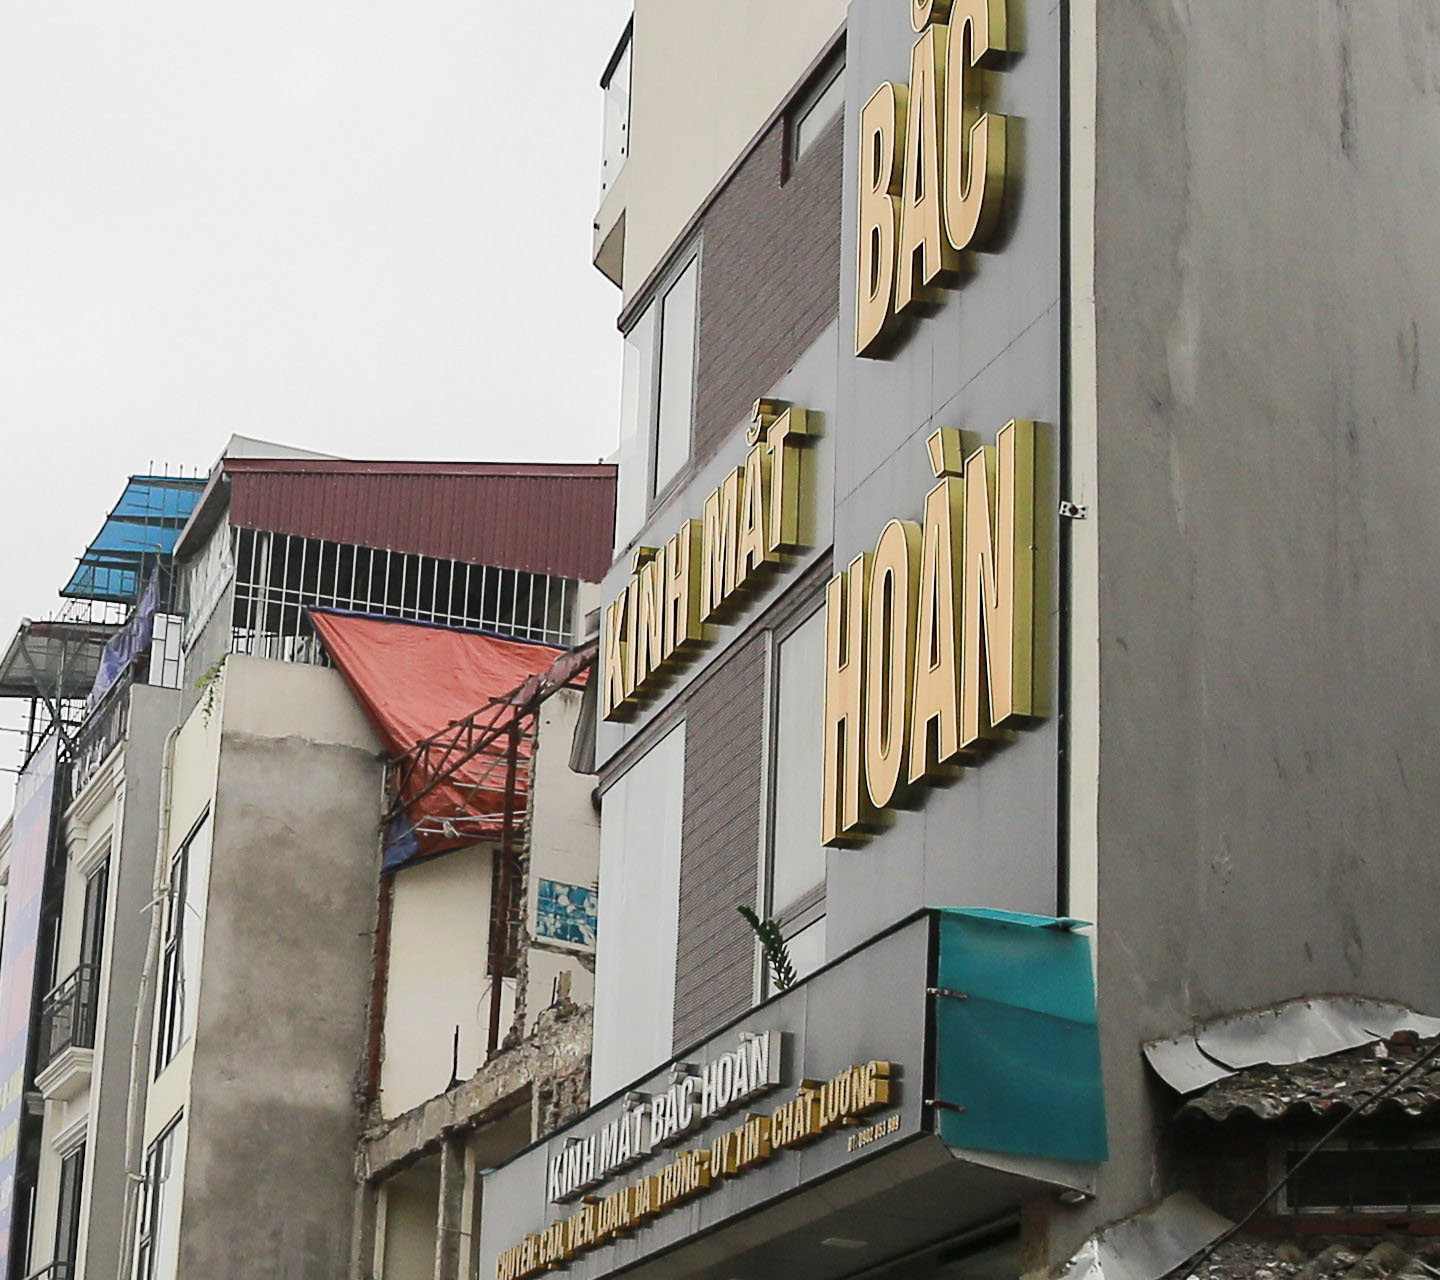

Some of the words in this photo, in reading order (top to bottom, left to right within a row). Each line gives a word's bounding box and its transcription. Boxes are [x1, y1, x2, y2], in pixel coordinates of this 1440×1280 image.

[602, 518, 696, 721] KÍNH
[700, 398, 813, 623] MẮT
[822, 418, 1028, 847] HOÀN
[549, 1136, 597, 1203] KÍNH
[600, 1091, 648, 1168] MẮT
[651, 1062, 697, 1146] BẮC
[701, 1030, 775, 1118] HOÀN
[711, 1132, 732, 1177] UY
[735, 1113, 761, 1167] TÍN
[772, 1079, 815, 1149] CHẤT
[819, 1061, 880, 1127] LƯỢNG
